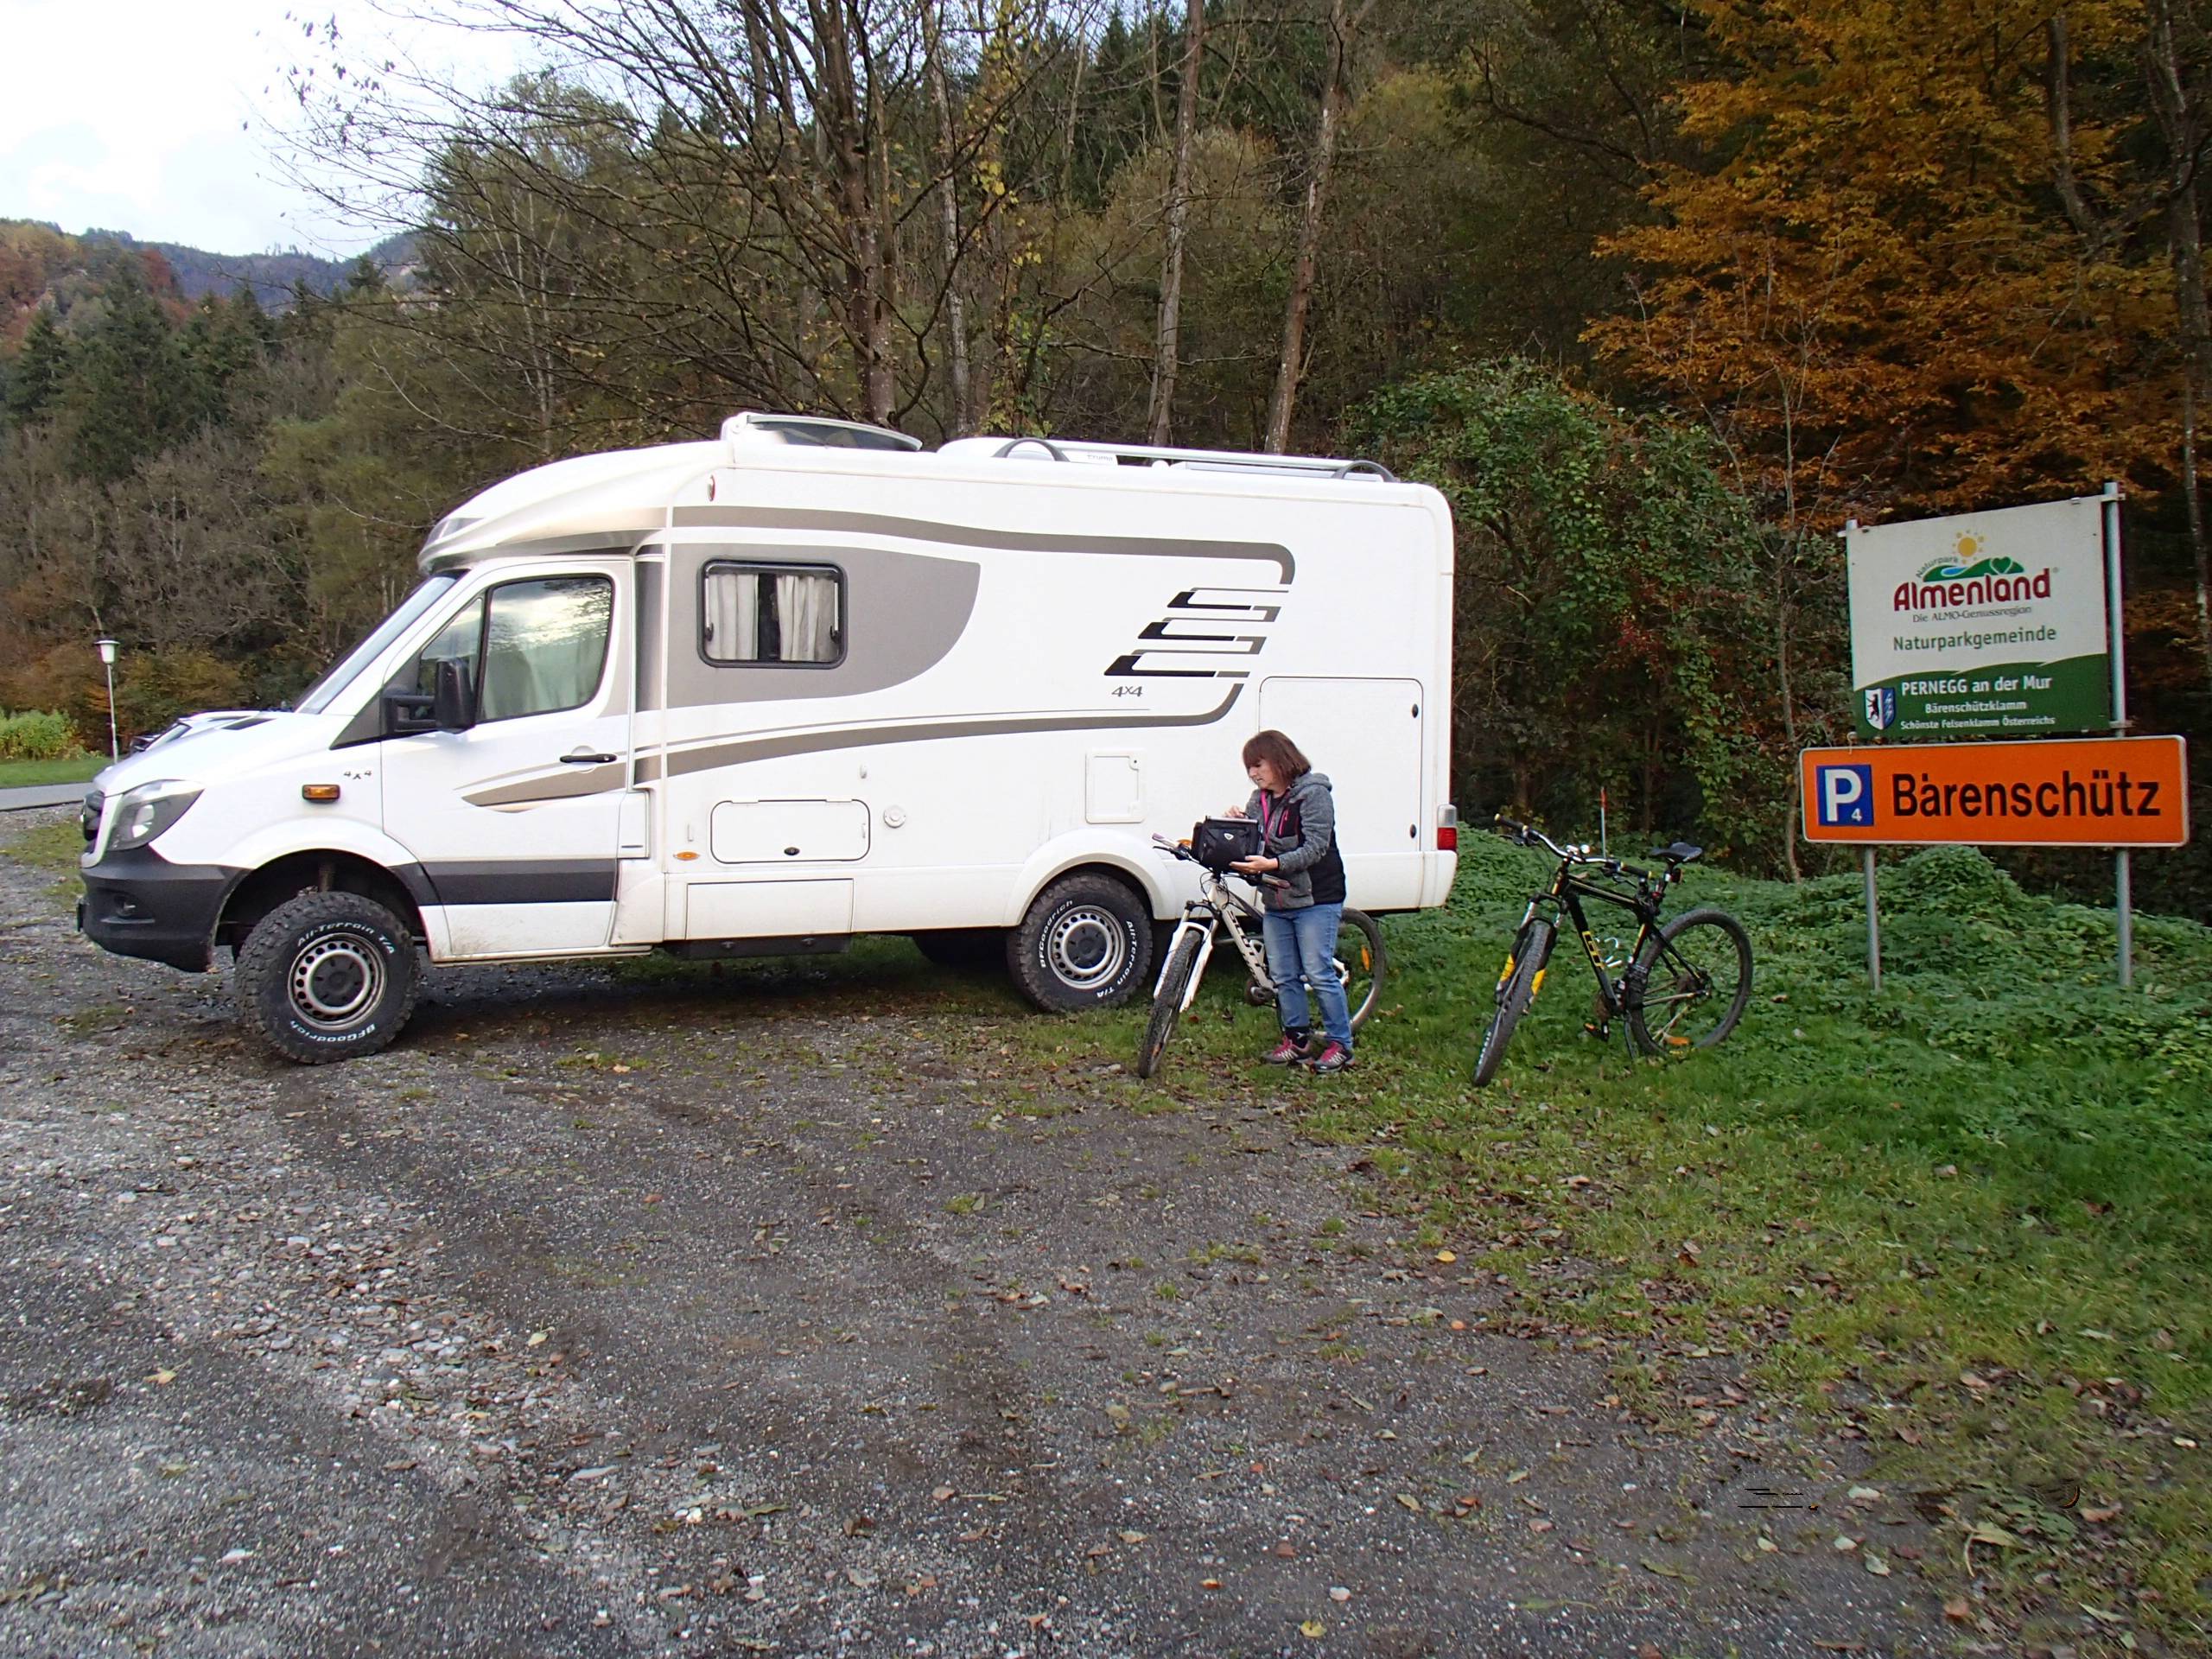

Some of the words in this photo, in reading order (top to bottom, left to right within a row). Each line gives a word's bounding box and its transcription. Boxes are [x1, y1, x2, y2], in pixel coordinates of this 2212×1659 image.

[1894, 568, 2050, 611] Almenland
[1912, 613, 1929, 623] Die
[1893, 626, 2056, 652] Naturparkgemeinde
[1902, 679, 1967, 696] PERNEGG
[1972, 683, 1989, 692] an
[1994, 677, 2018, 691] der
[2024, 675, 2052, 690] Mur
[1924, 700, 2027, 714] Bärenschützklamm
[1900, 719, 1939, 730] Schönste
[1942, 718, 1999, 728] Felsenklamm
[2002, 715, 2056, 726] Österreichs
[1825, 769, 1862, 822] P
[1851, 808, 1863, 822] 4
[1892, 770, 2161, 817] Bärenschütz
[297, 921, 375, 947] All-Terrain
